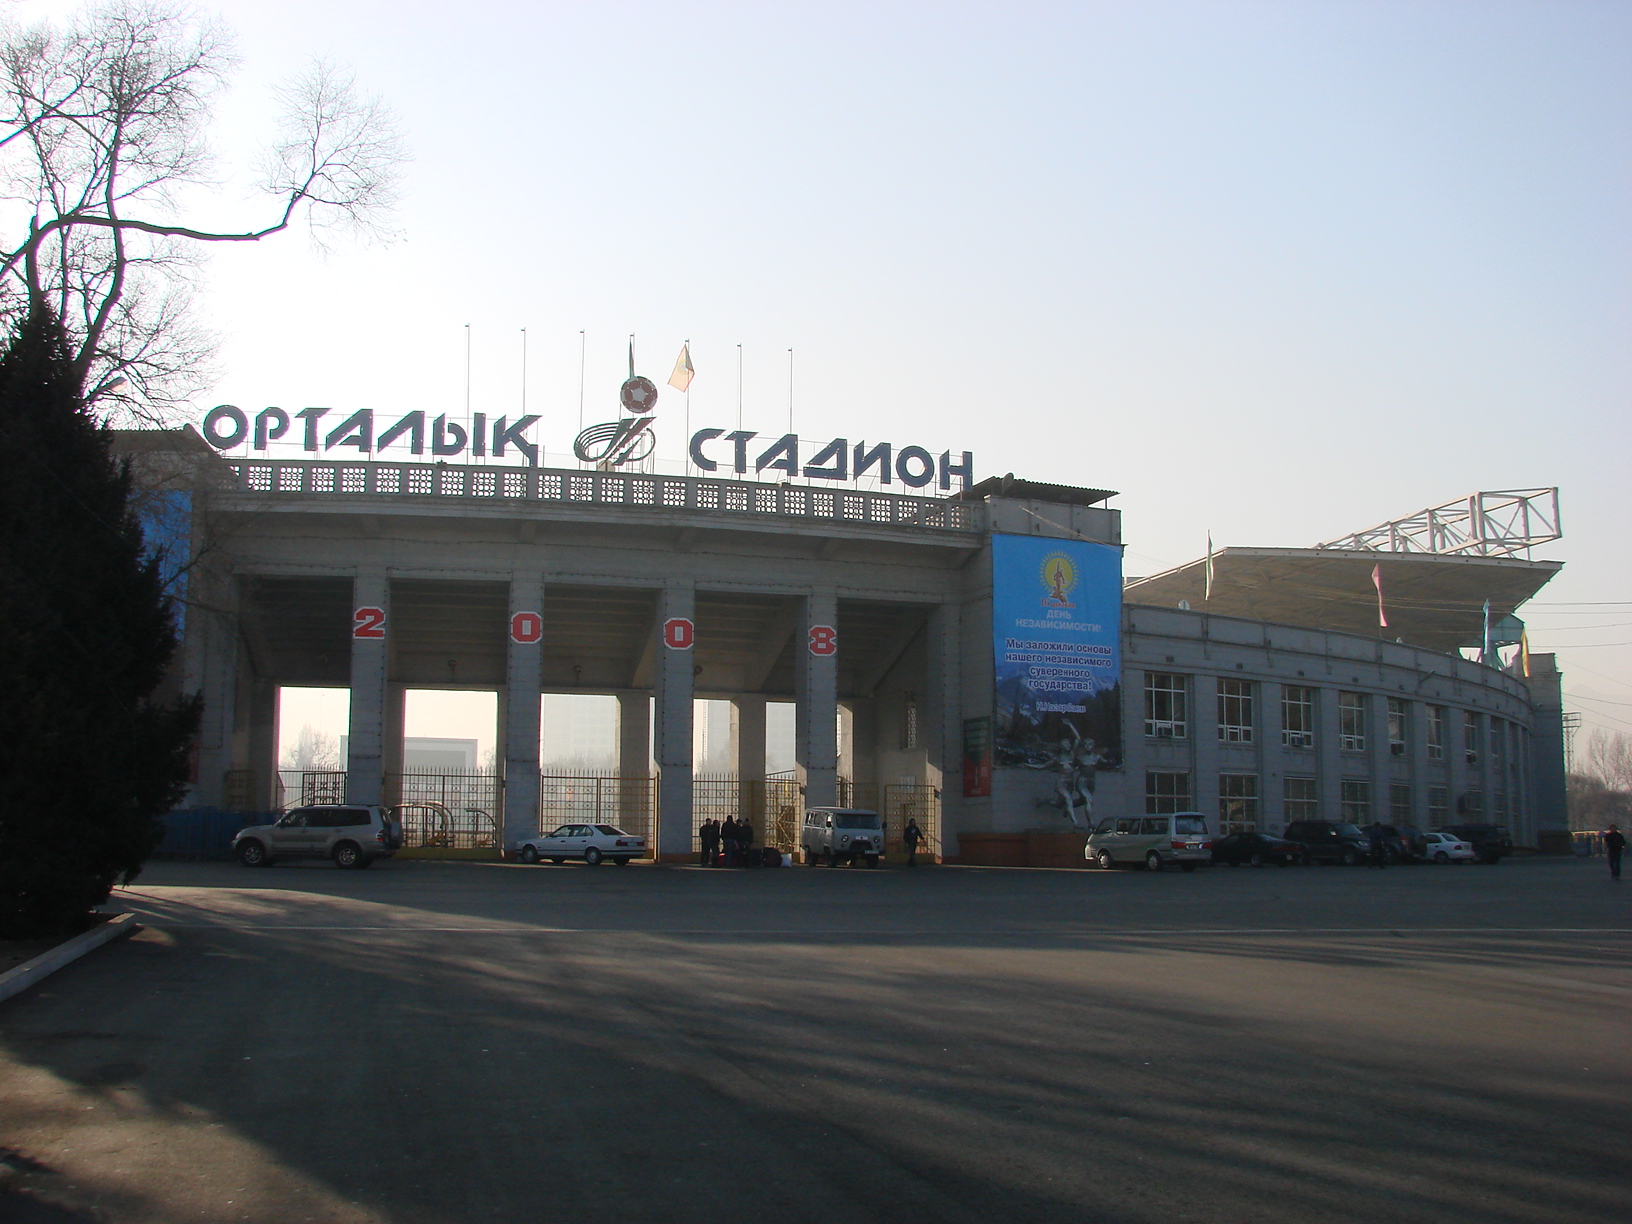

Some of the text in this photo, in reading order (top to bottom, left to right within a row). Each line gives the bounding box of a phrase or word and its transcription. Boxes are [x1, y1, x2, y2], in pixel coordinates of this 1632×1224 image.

[203, 404, 973, 491] ОРТАЛЫҚ СТАДИОН
[1046, 609, 1072, 620] ДЕНЬ
[353, 606, 837, 657] 2 0 0 8
[1015, 619, 1102, 633] НЕЗАВИСИМОСТИ!
[1006, 638, 1112, 655] Мы заложили основы
[1005, 652, 1112, 668] нашего независимого
[1029, 666, 1091, 679] суверенного
[1028, 679, 1092, 691] государства!
